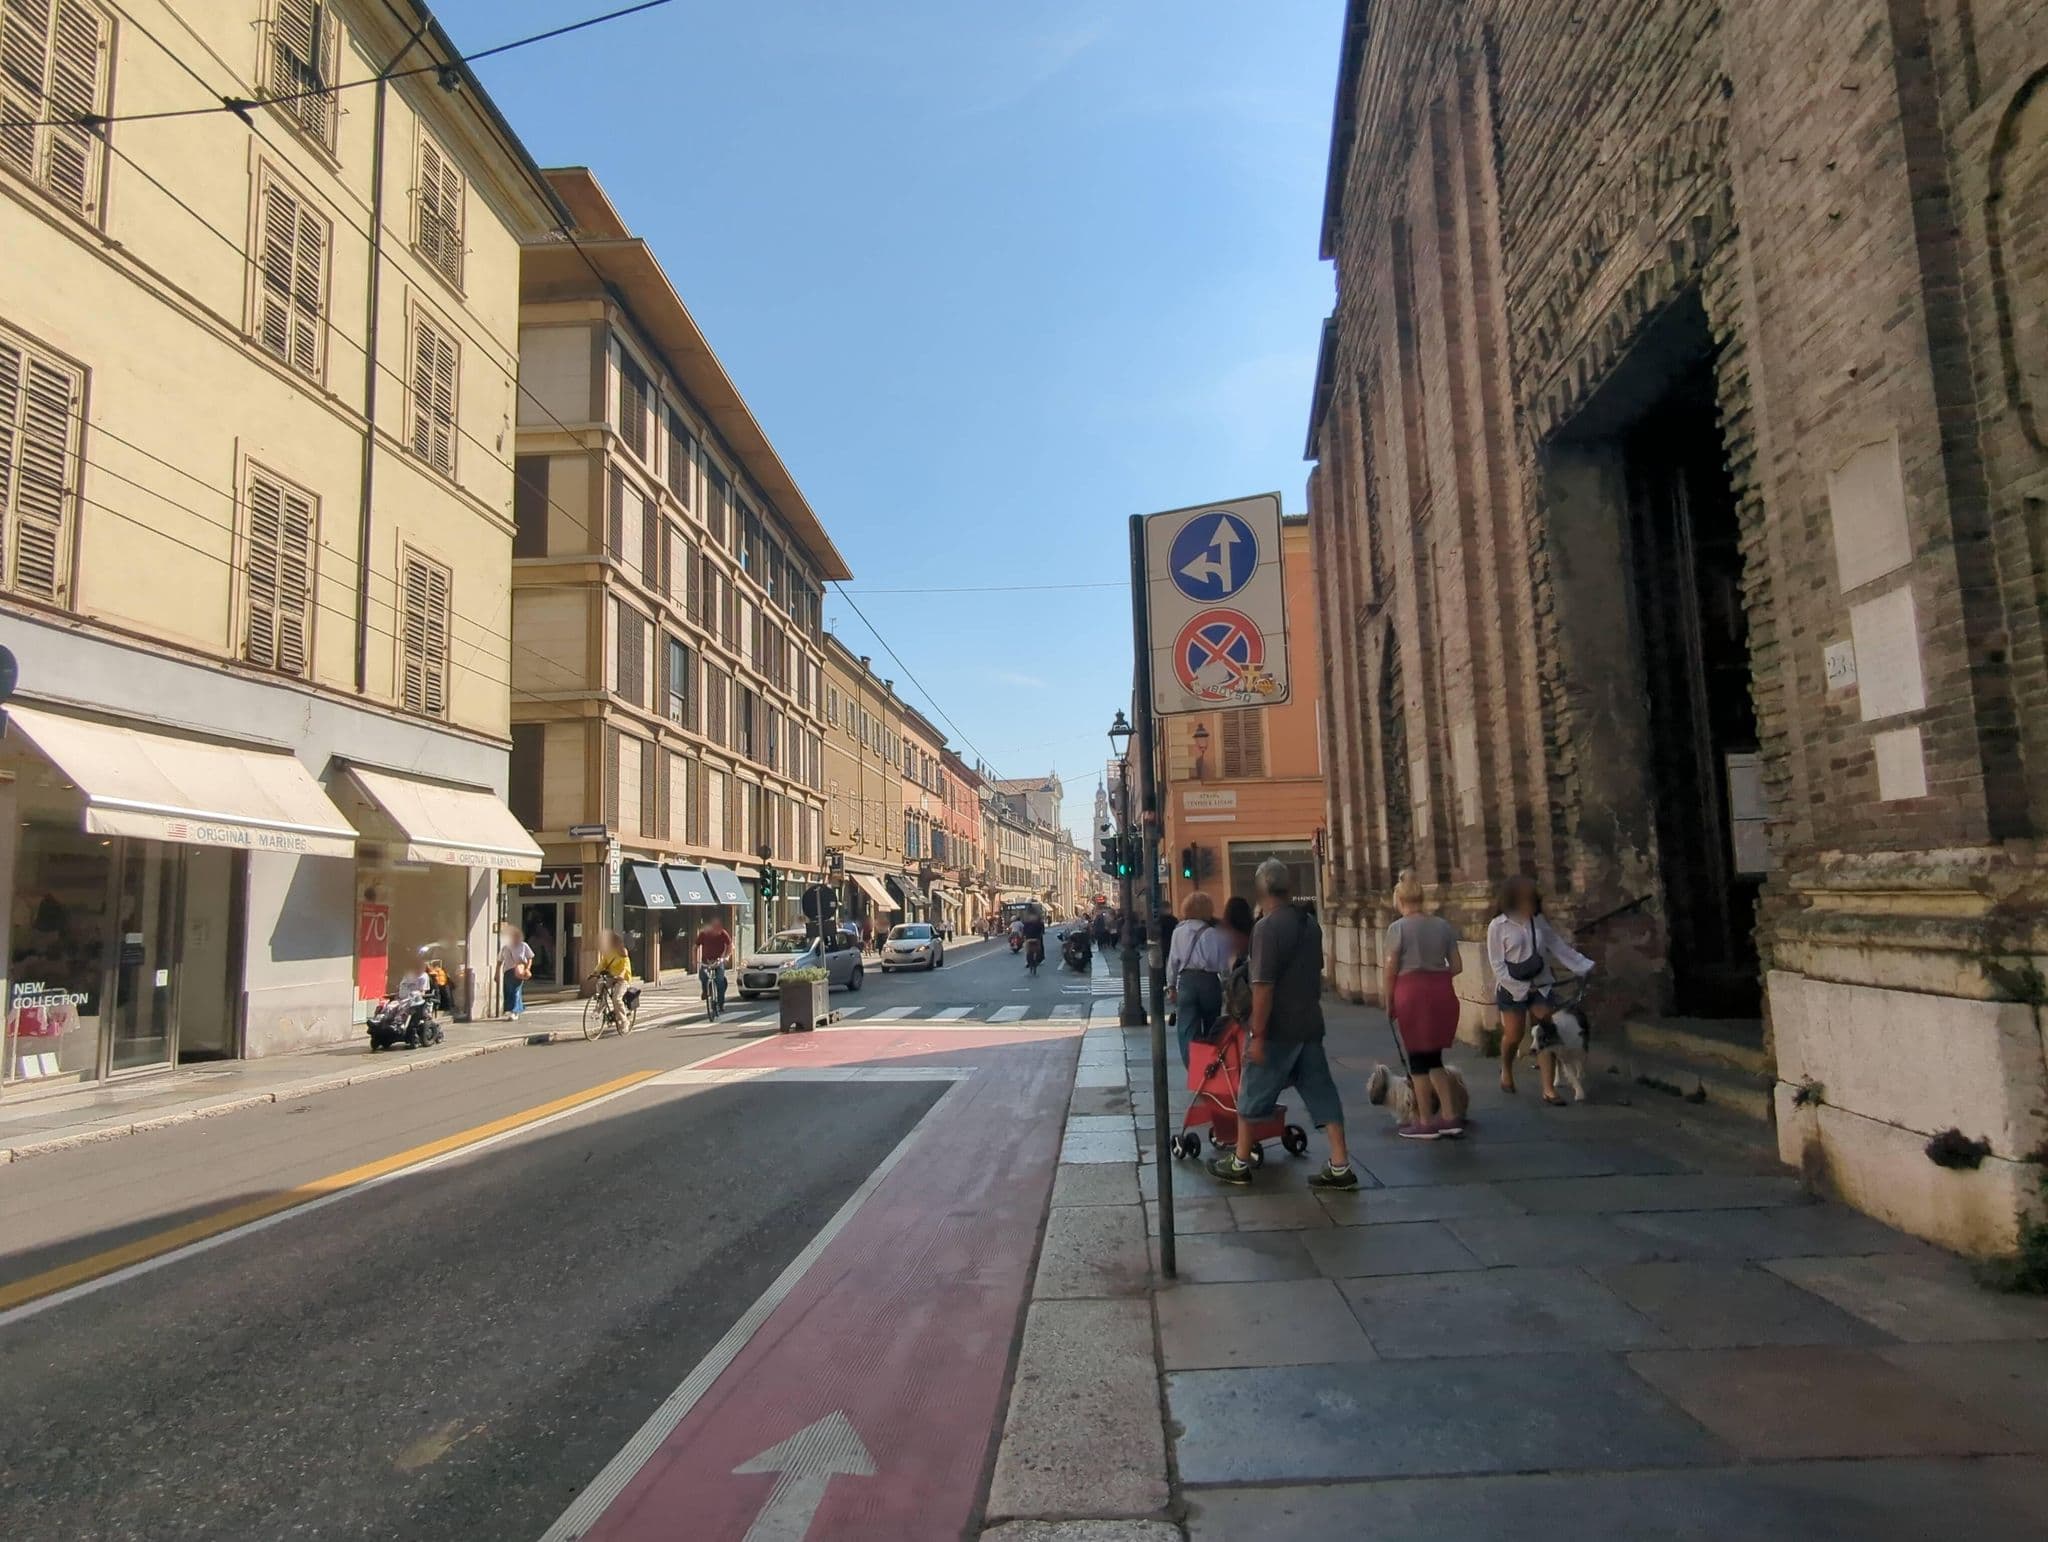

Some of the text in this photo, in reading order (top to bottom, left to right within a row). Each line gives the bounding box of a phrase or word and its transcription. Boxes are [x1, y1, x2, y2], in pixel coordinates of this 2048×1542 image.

[196, 827, 306, 850] ORIGINAL MARINES
[363, 911, 387, 941] 70
[14, 982, 45, 995] NEW
[13, 993, 89, 1009] COLLECTION
